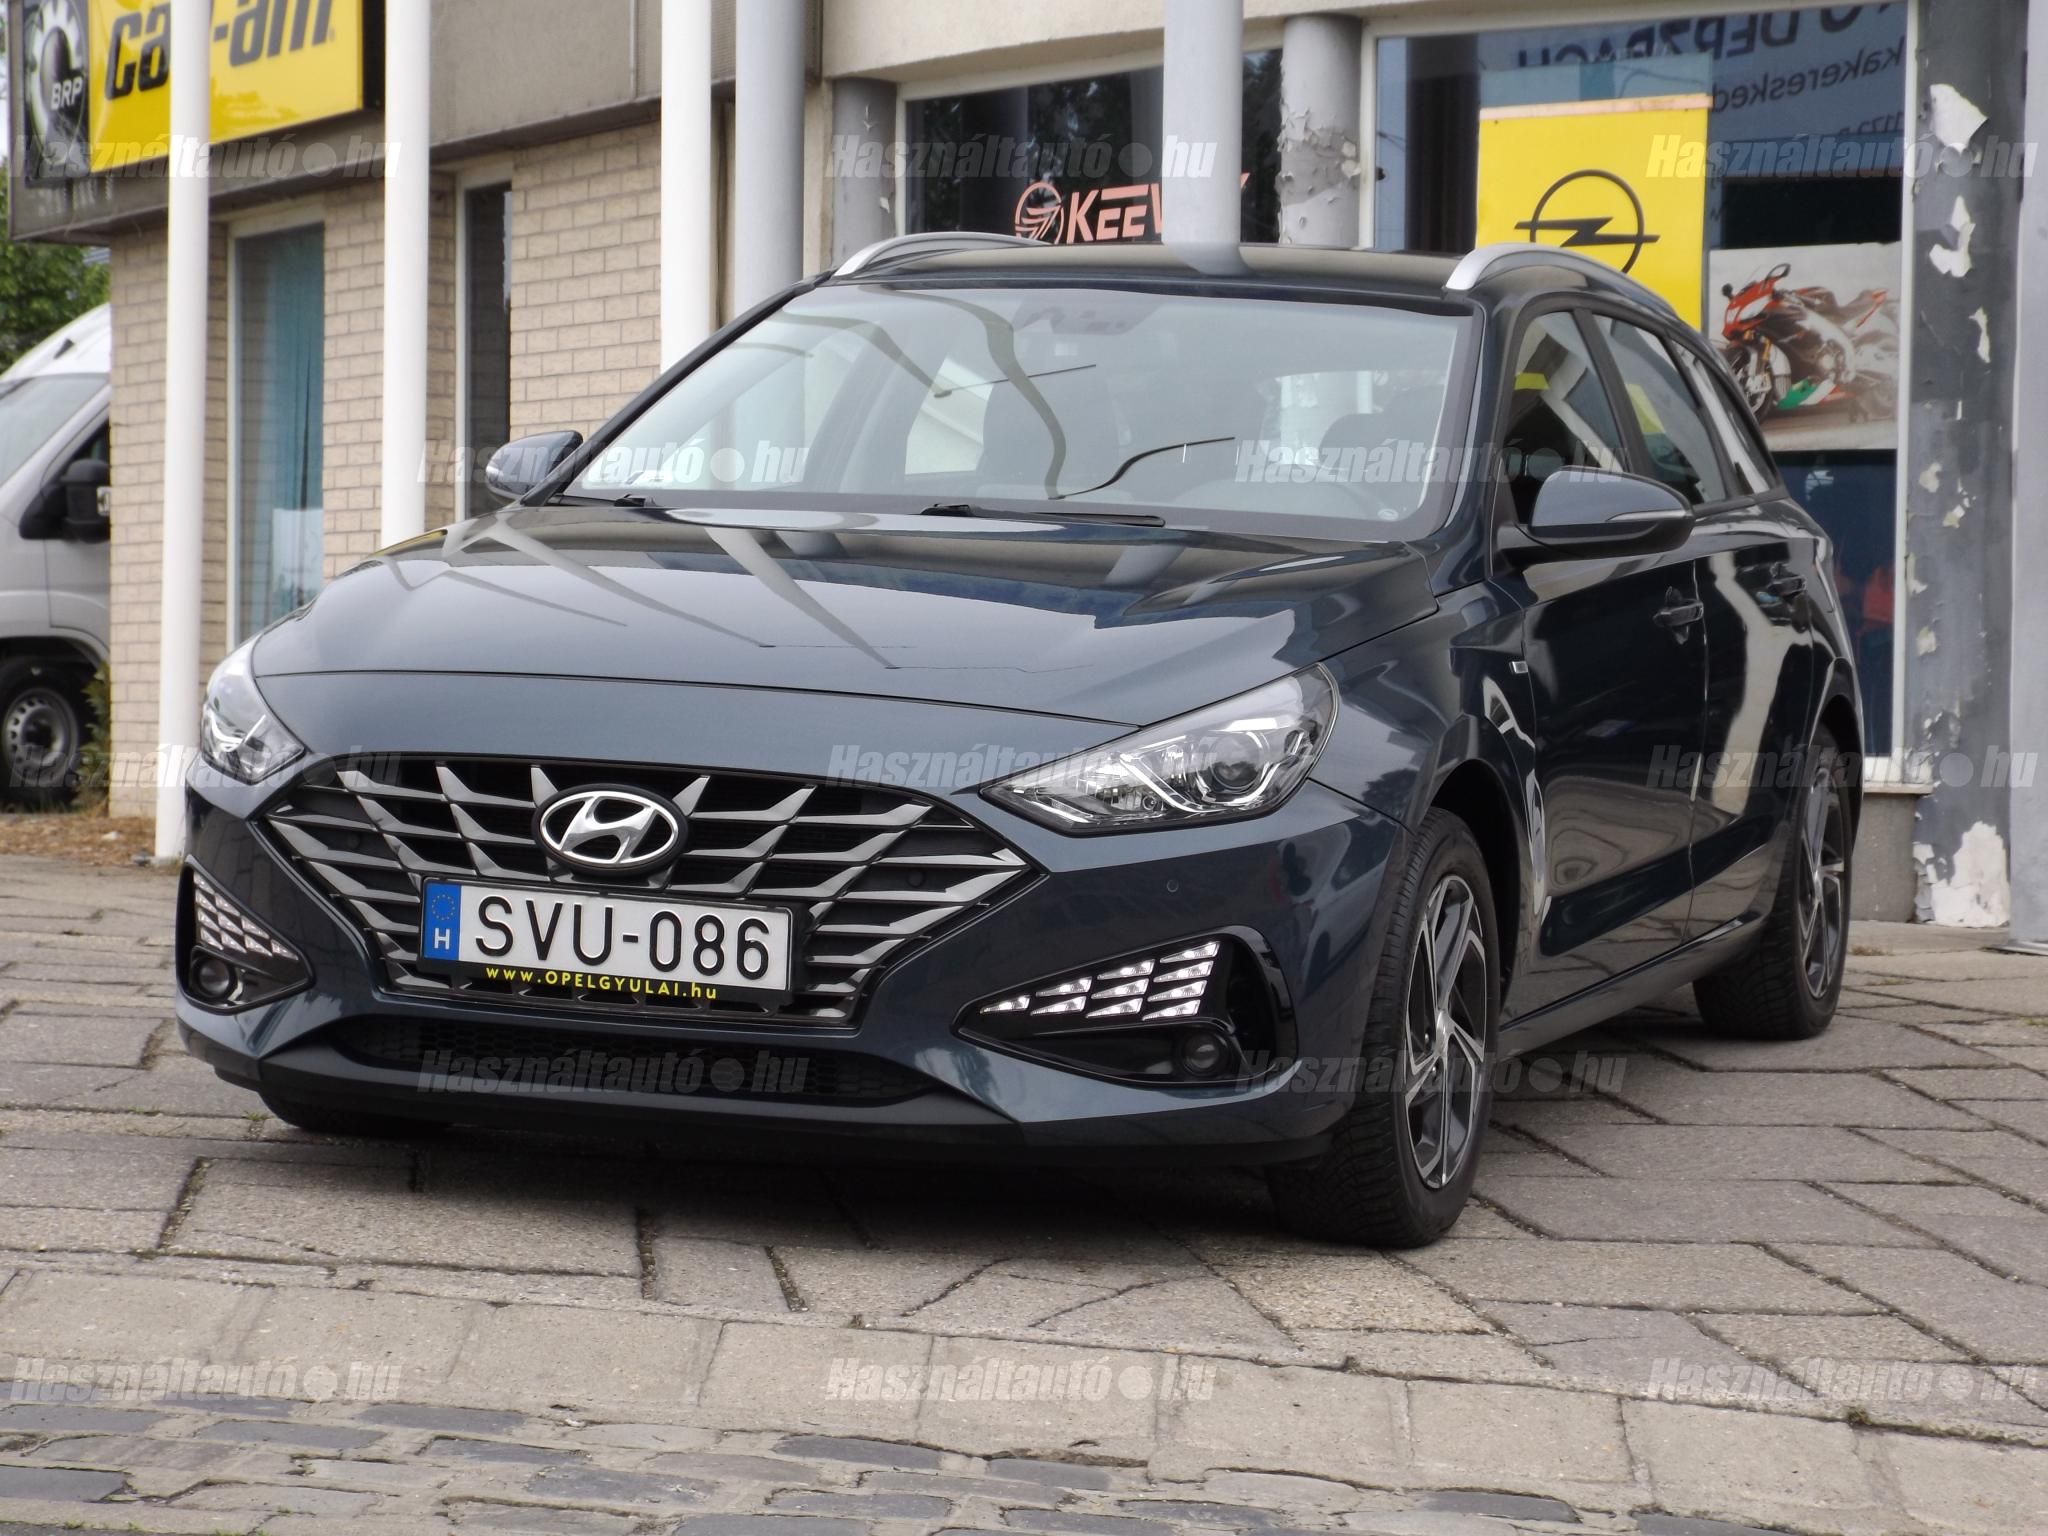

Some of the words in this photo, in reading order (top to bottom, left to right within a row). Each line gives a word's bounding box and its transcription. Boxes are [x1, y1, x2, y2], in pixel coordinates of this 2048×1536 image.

[50, 76, 83, 110] BRP
[434, 928, 451, 950] H
[475, 896, 769, 980] SVU-086
[485, 966, 717, 999] www.OPELGYULAI.hu
